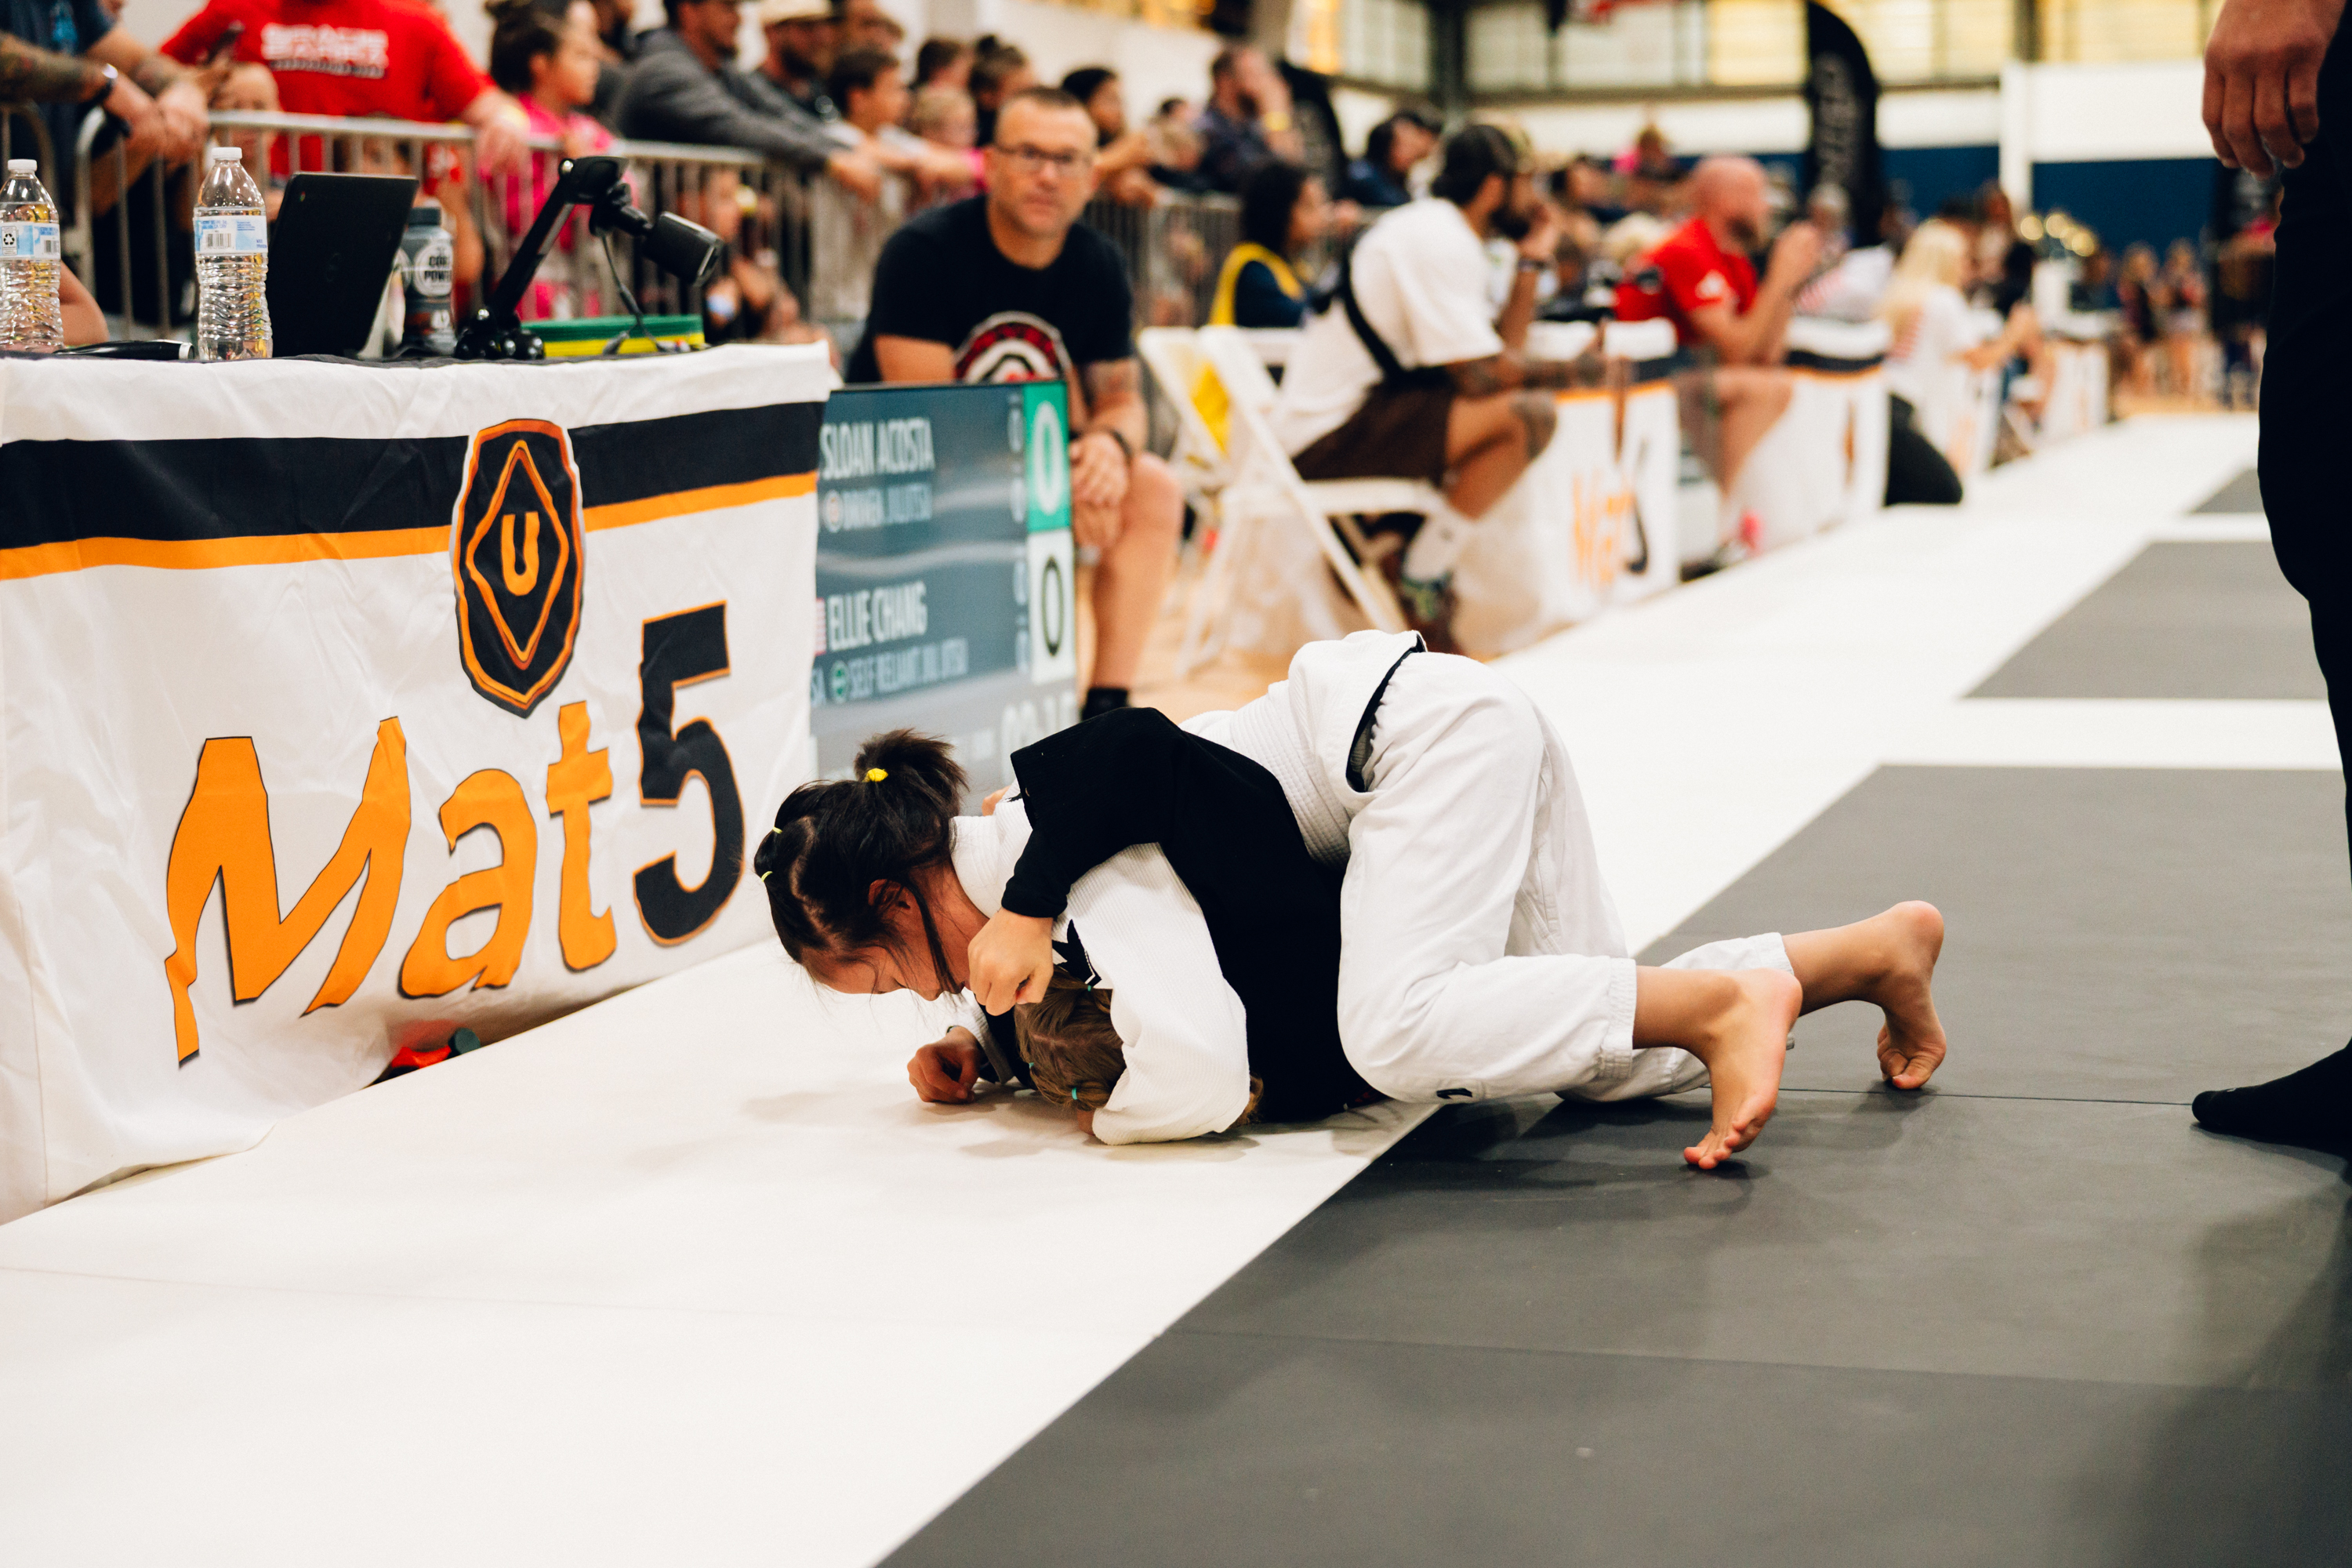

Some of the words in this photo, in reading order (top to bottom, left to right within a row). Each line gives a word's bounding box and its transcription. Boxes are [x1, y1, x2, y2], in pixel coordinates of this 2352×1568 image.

[819, 422, 875, 480] SLOAN
[875, 416, 935, 474] ACOSTA
[1032, 399, 1065, 516] 0
[501, 511, 541, 596] U
[827, 589, 872, 652] ELLIE
[870, 579, 928, 644] CHANG
[1041, 556, 1065, 657] 0
[165, 700, 617, 1066] Mat
[633, 600, 746, 947] 5
